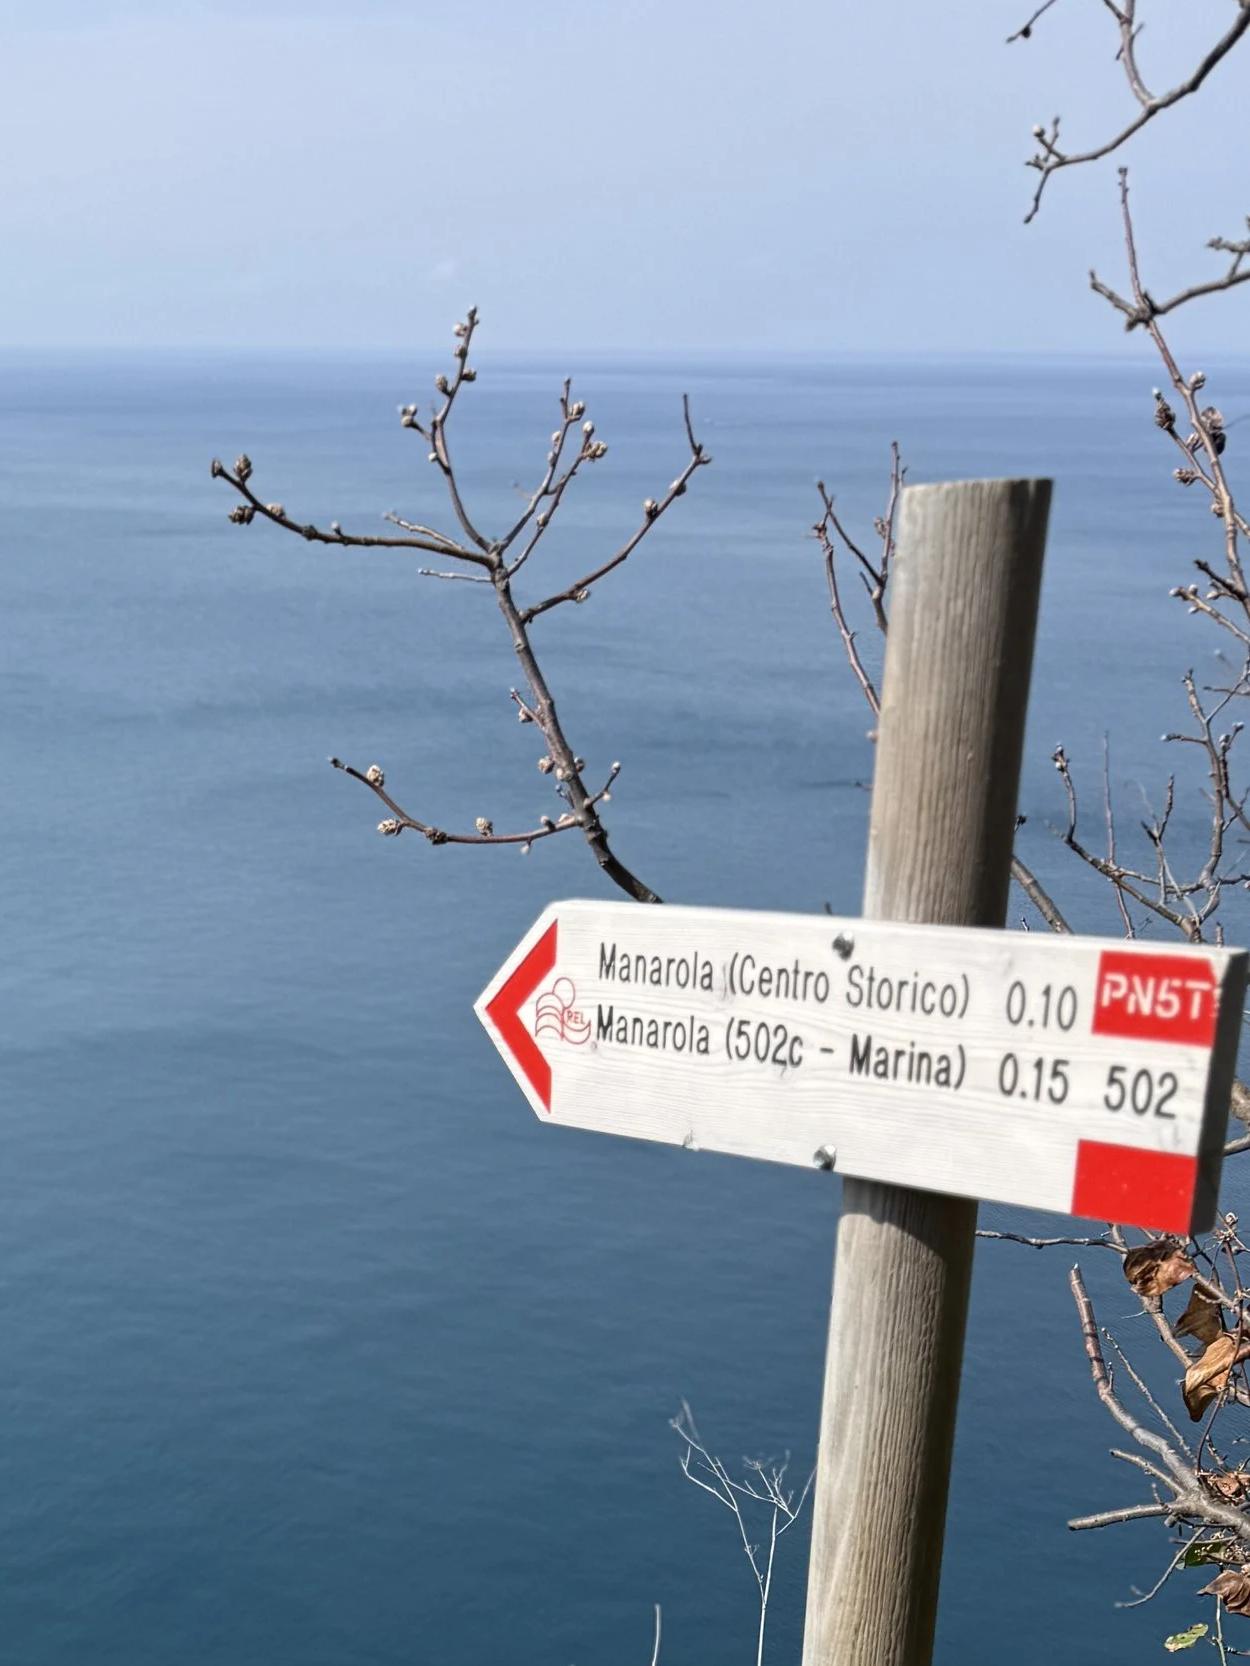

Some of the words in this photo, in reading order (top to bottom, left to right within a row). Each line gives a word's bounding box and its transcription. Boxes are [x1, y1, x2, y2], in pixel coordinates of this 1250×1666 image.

[599, 941, 714, 992] Manarola
[728, 951, 830, 1004] (Centro
[846, 963, 970, 1019] Storico)
[1006, 980, 1078, 1032] 0.10
[596, 1003, 710, 1056] Manarola
[725, 1016, 804, 1068] (502c
[819, 1046, 835, 1055] -
[849, 1033, 967, 1091] Marina)
[998, 1052, 1071, 1105] 0.15
[1104, 1064, 1179, 1120] 502
